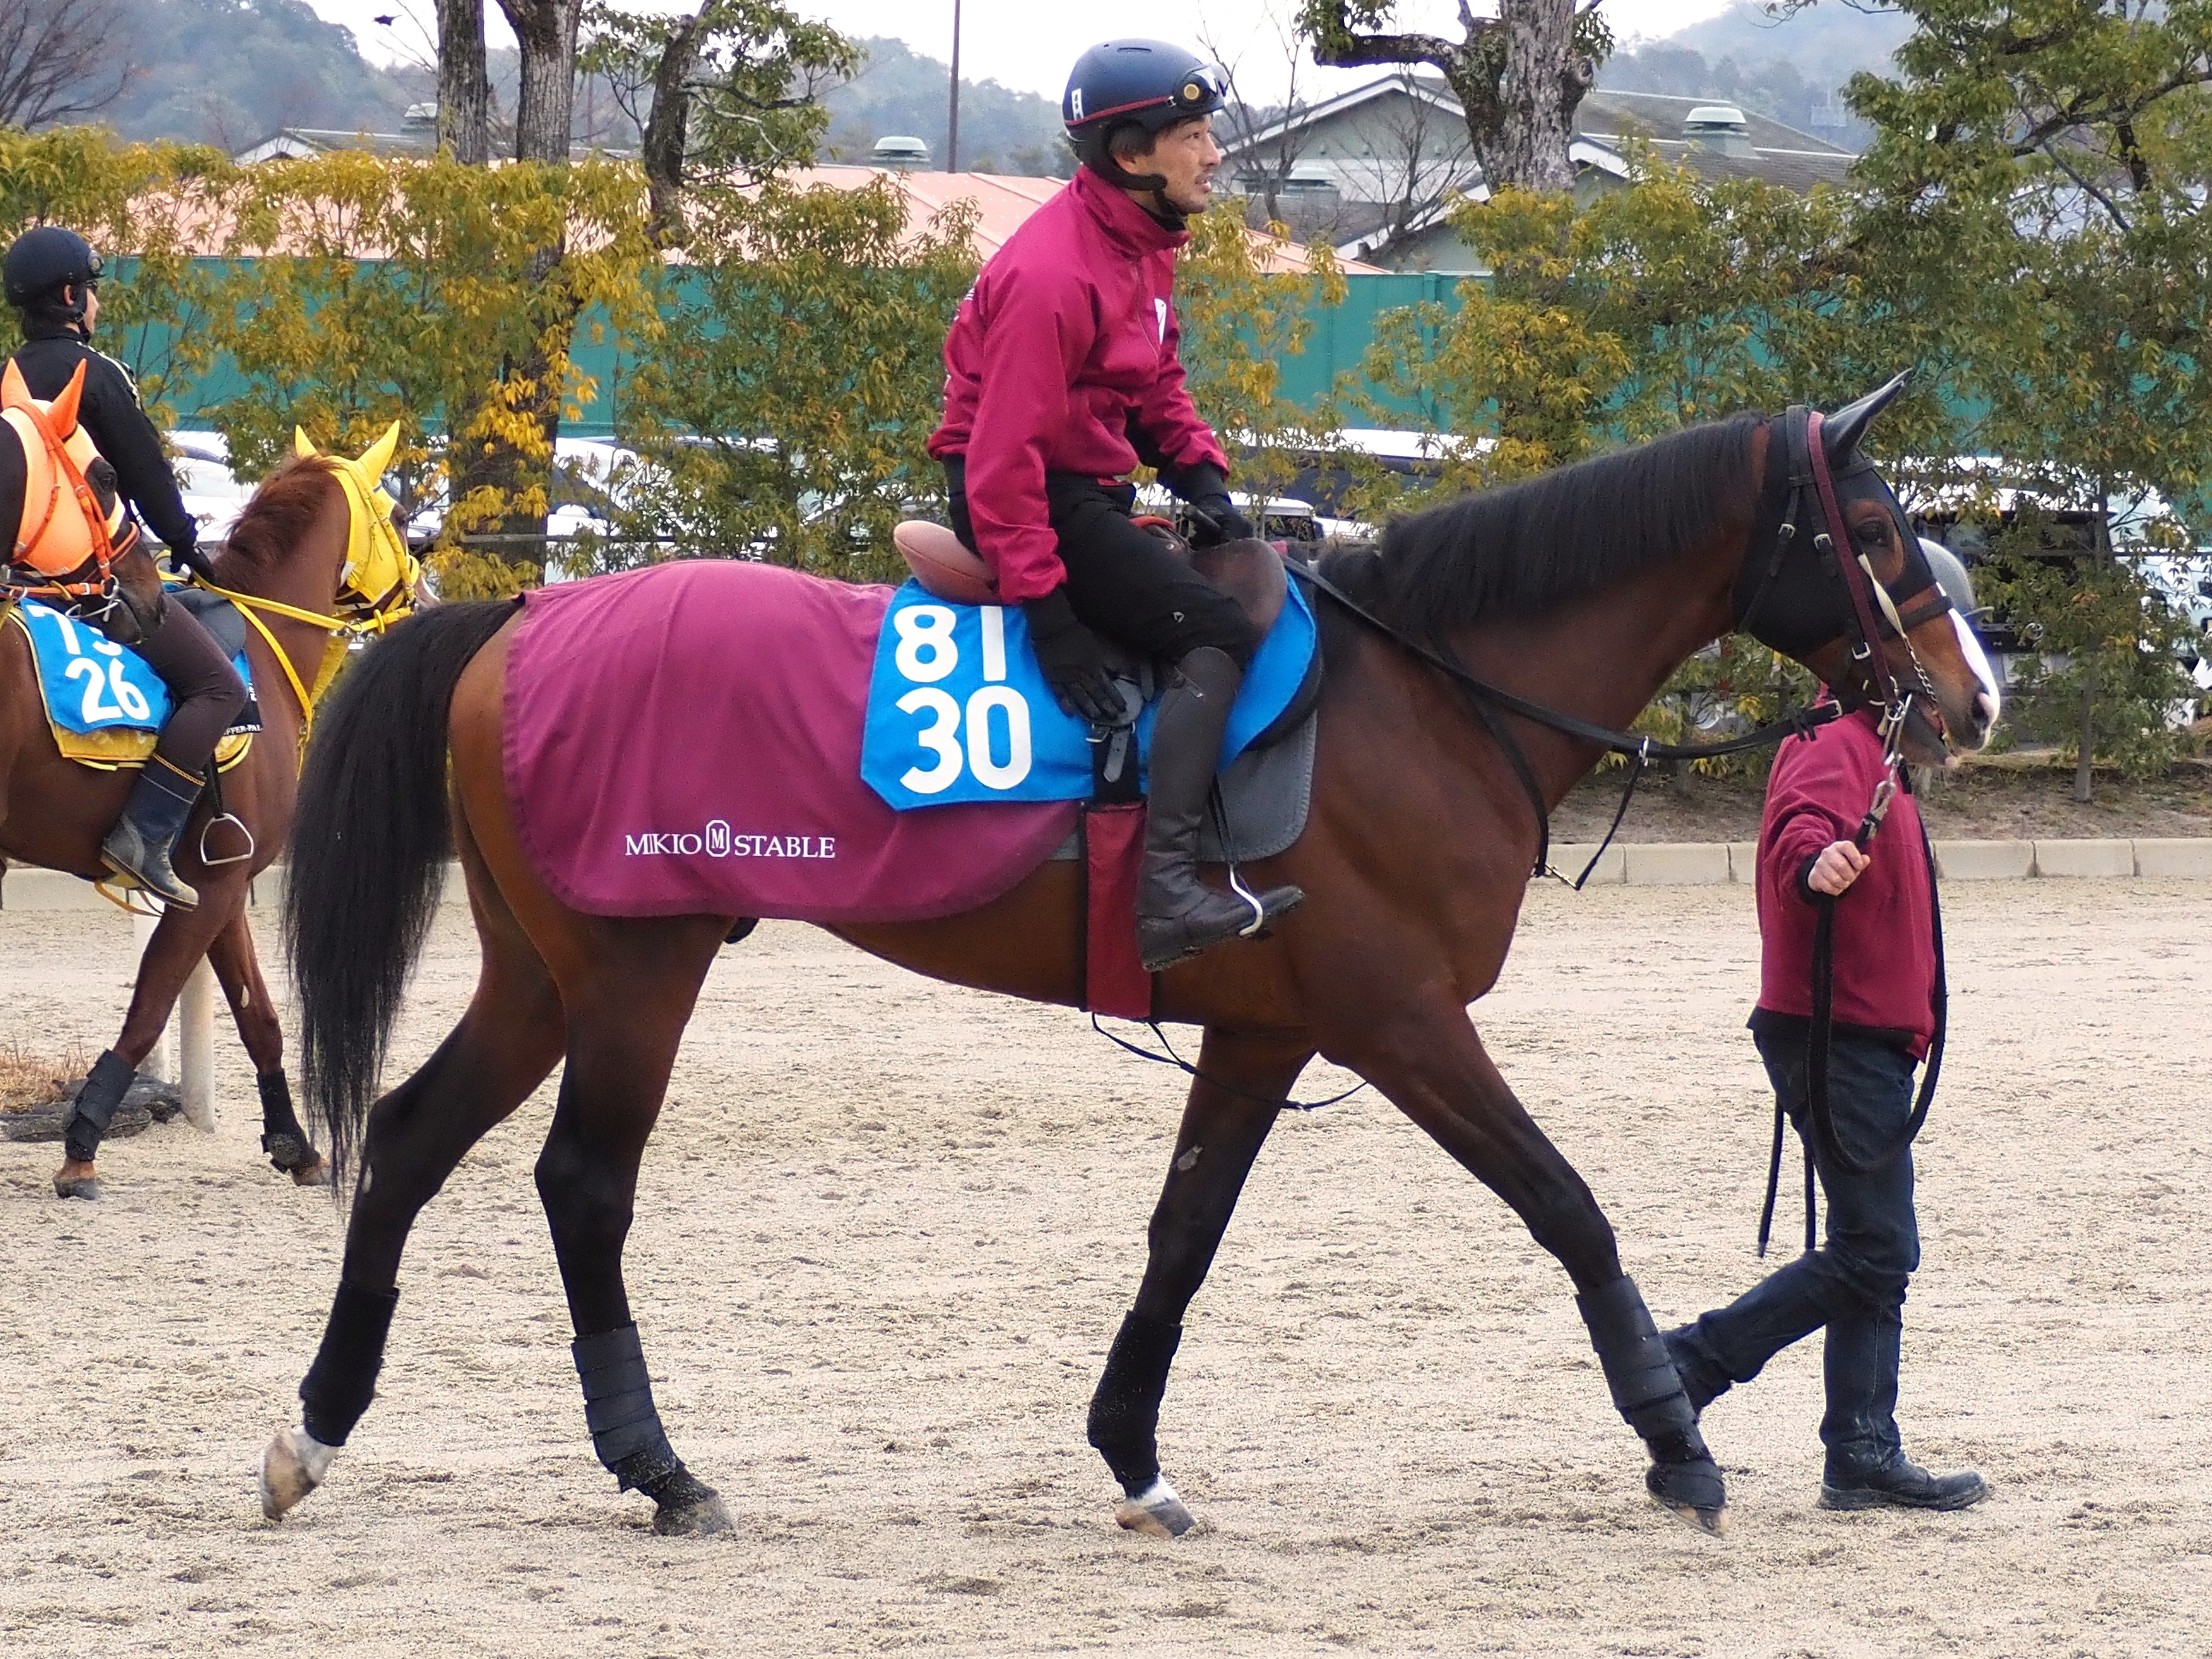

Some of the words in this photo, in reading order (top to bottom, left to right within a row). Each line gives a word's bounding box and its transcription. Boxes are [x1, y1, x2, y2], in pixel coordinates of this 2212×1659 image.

[894, 605, 1006, 683] 81
[64, 657, 150, 723] 26
[896, 686, 1032, 794] 30
[625, 833, 702, 856] MIKIO
[734, 835, 835, 858] STABLE
